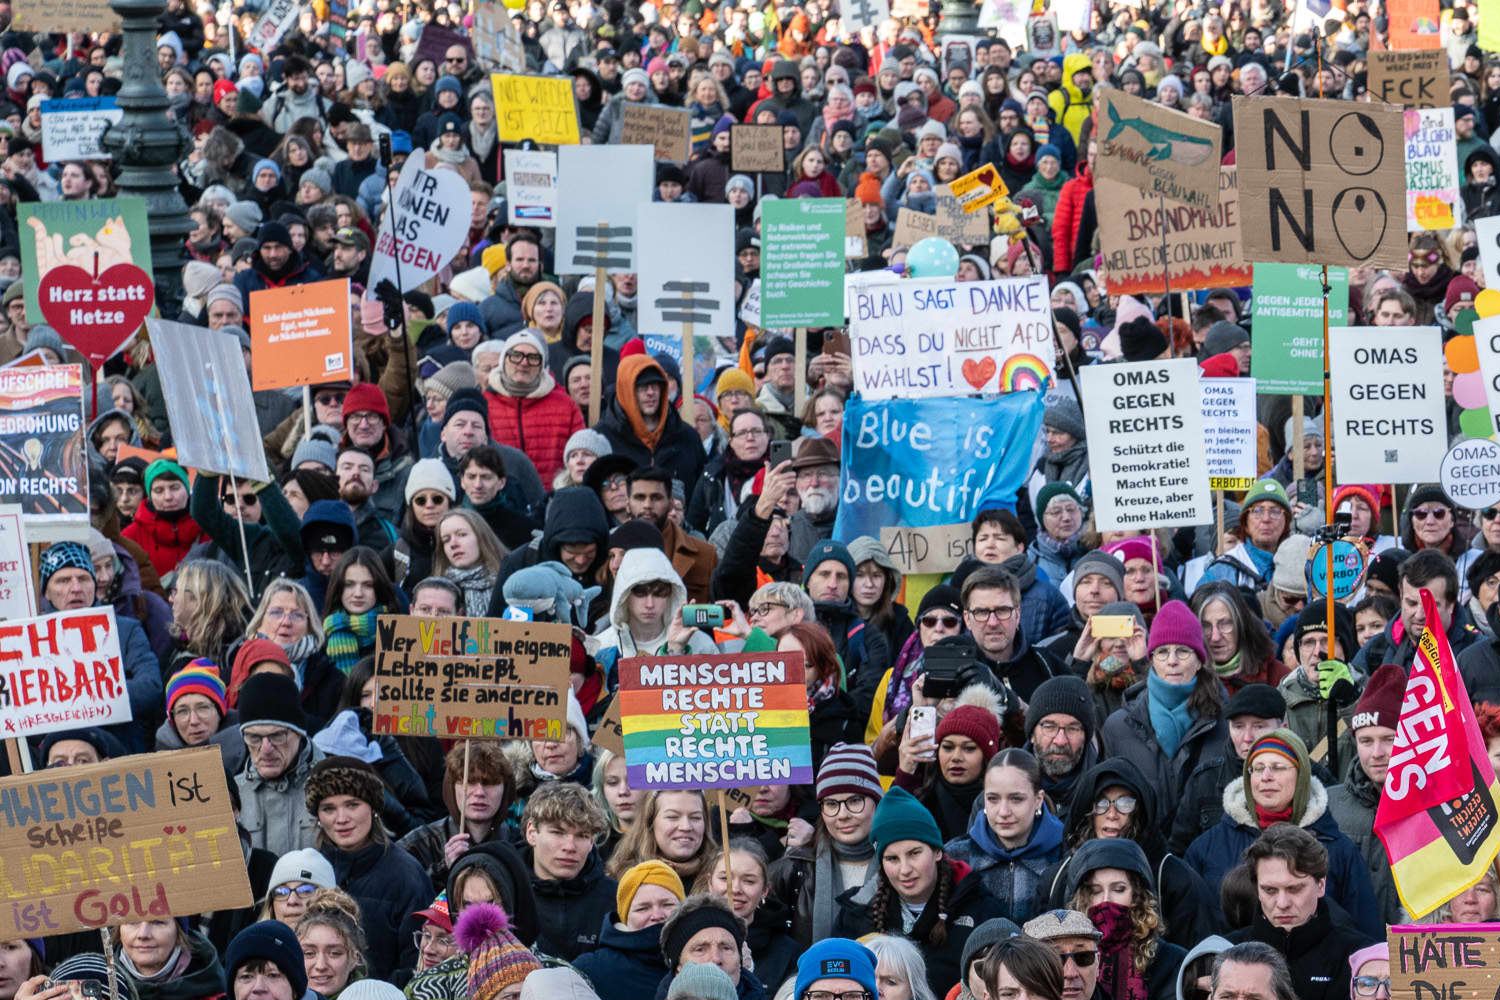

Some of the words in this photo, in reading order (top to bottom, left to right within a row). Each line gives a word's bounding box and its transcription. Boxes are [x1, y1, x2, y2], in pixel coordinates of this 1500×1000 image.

[499, 80, 522, 101] NIE
[529, 80, 572, 106] WIEDER
[1381, 77, 1436, 101] FCK
[503, 110, 526, 131] IST
[532, 109, 573, 137] JETZT
[49, 286, 93, 303] Herz
[97, 284, 146, 301] statt
[857, 292, 903, 321] BLAU
[913, 287, 958, 311] SAGT
[969, 282, 1047, 316] DANKE,
[1256, 296, 1290, 307] GEGEN
[1292, 296, 1325, 307] JEDEN
[70, 308, 125, 325] Hetze
[858, 334, 906, 356] DASS
[918, 332, 945, 354] DU
[954, 325, 1001, 348] NICHT
[1011, 322, 1050, 350] AfD
[1290, 348, 1318, 358] OHNE
[1353, 347, 1419, 365] OMAS
[1113, 369, 1171, 387] OMAS
[1112, 391, 1176, 411] GEGEN
[1204, 387, 1234, 395] OMAS
[1349, 383, 1427, 401] GEGEN
[856, 407, 933, 450] Blue
[964, 412, 994, 459] is
[1108, 415, 1184, 435] RECHTS
[1218, 427, 1251, 435] bleiben
[1346, 418, 1434, 437] RECHTS
[1113, 442, 1162, 457] Schützt
[1165, 441, 1185, 453] die
[1453, 446, 1497, 461] OMAS
[1111, 457, 1191, 474] Demokratie!
[1451, 464, 1500, 479] GEGEN
[1116, 477, 1156, 491] Macht
[1159, 476, 1189, 488] Eure
[1114, 495, 1164, 508] Kreuze,
[1165, 493, 1194, 504] aber
[1116, 512, 1147, 524] ohne
[1149, 507, 1196, 522] Haken!!
[888, 527, 929, 571] AfD
[378, 619, 417, 652] Wer
[494, 629, 513, 656] im
[513, 630, 571, 665] eigenen
[376, 652, 438, 678] Leben
[442, 657, 522, 687] genießt,
[639, 660, 786, 687] MENSCHEN
[378, 678, 435, 701] sollte
[440, 684, 470, 703] sie
[474, 686, 559, 706] anderen
[661, 687, 765, 711] RECHTE
[376, 703, 438, 736] nicht
[445, 706, 563, 739] verwehren
[679, 711, 760, 736] STATT
[665, 734, 769, 759] RECHTE
[645, 757, 791, 784] MENSCHEN
[26, 816, 125, 849] scheiße
[11, 899, 60, 933] ist
[73, 881, 171, 927] Gold
[1399, 931, 1488, 973] HÄTTE
